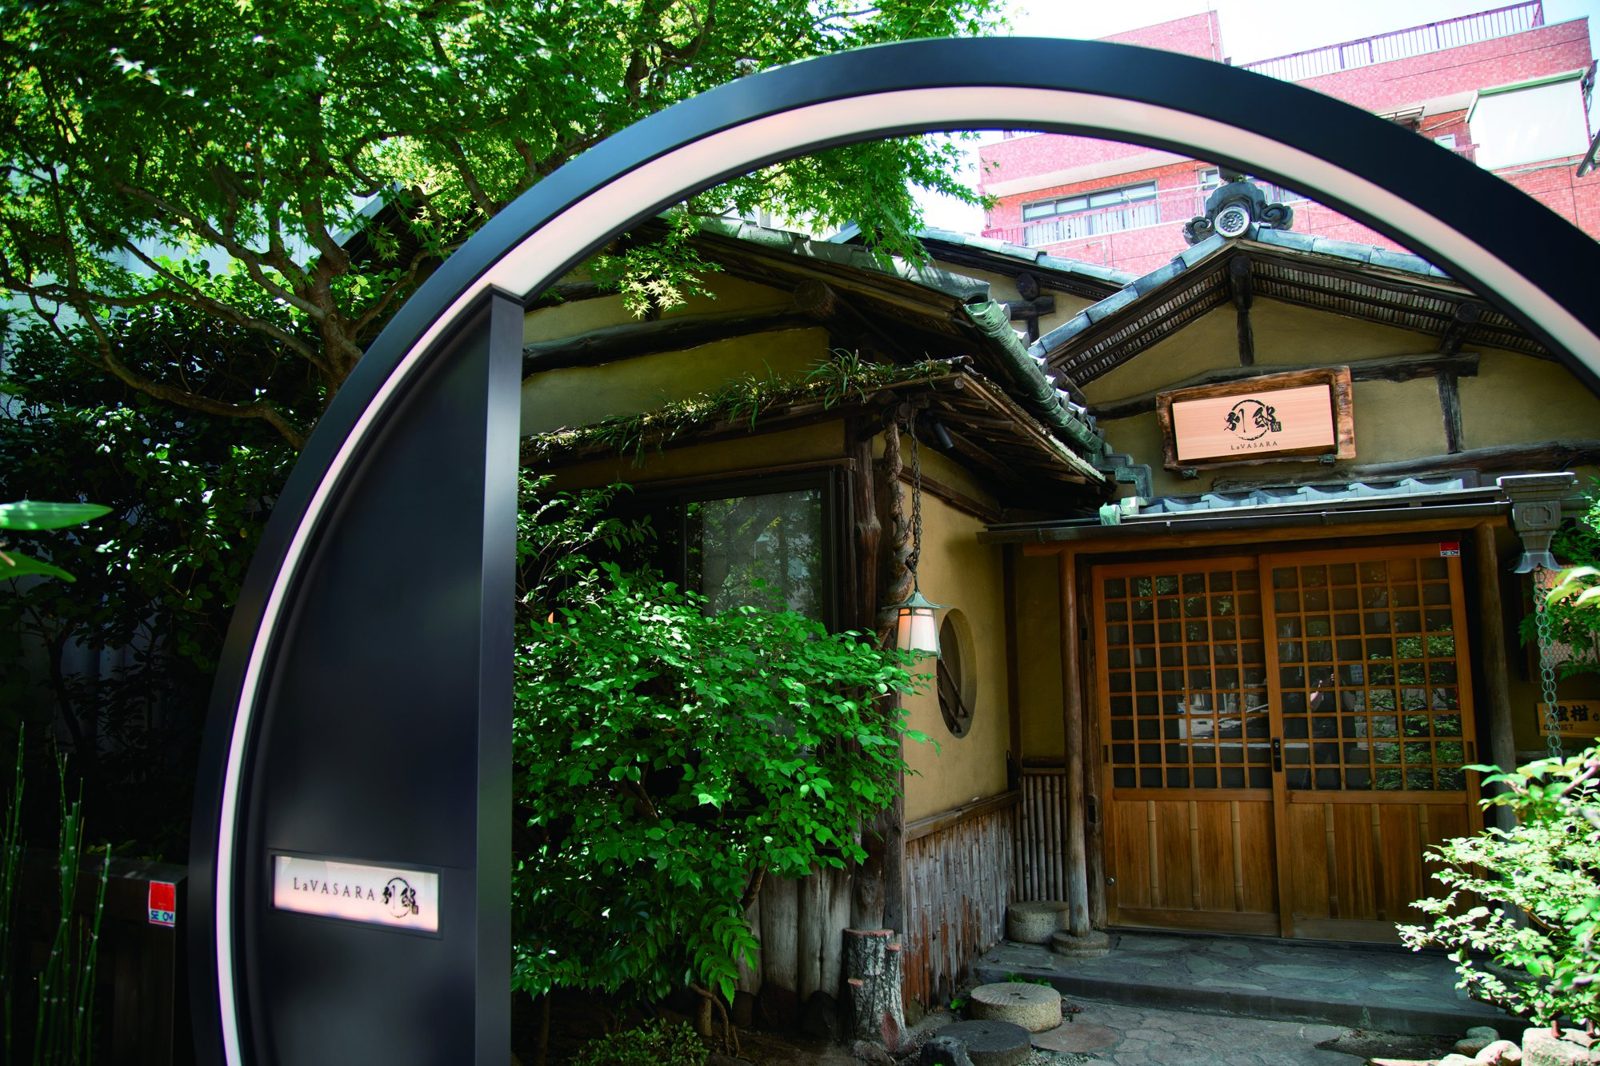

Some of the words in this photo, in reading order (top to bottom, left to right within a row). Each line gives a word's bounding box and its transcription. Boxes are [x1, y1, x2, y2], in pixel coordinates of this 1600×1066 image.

[1231, 441, 1278, 450] LaVASARA
[293, 877, 375, 901] LaVASARA
[150, 910, 174, 922] SEOM
